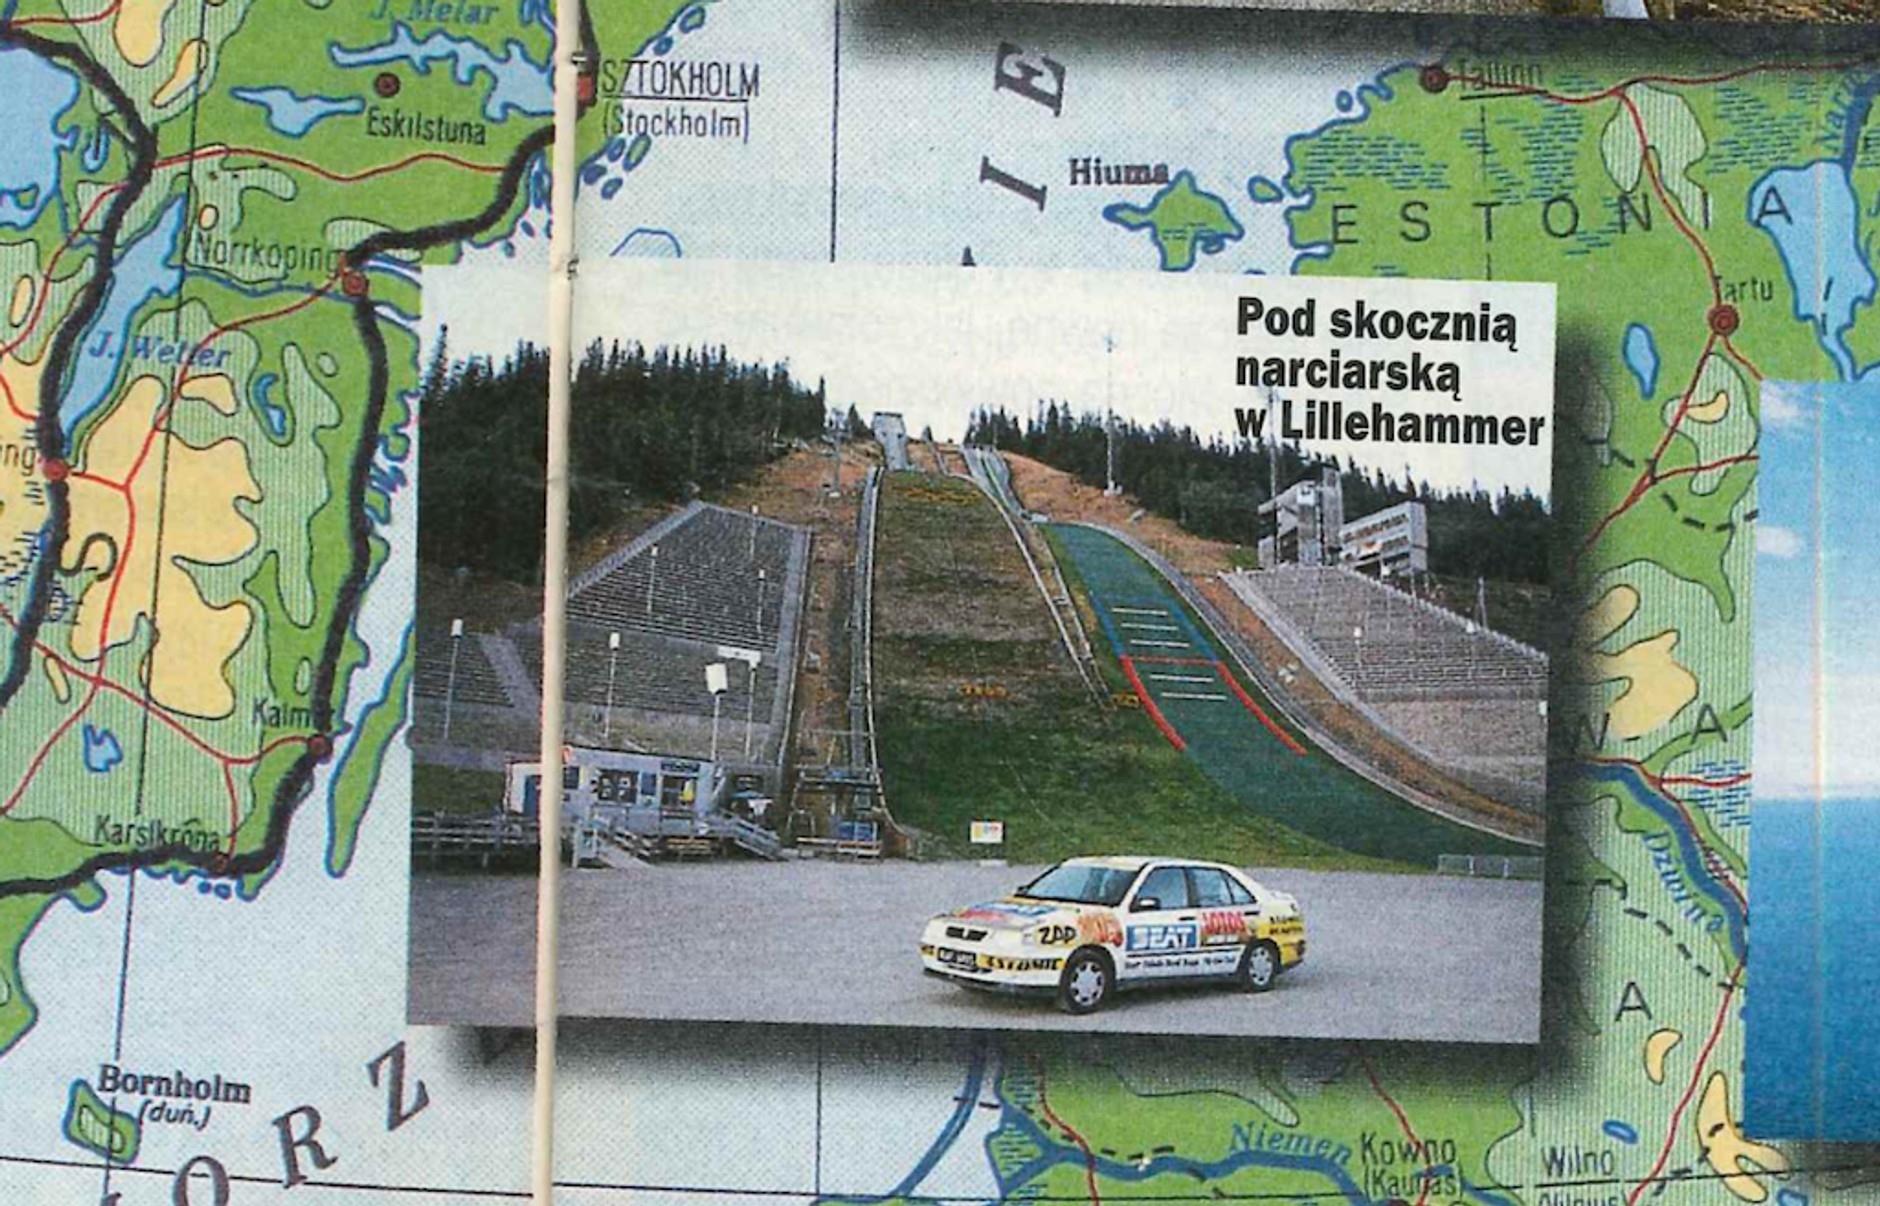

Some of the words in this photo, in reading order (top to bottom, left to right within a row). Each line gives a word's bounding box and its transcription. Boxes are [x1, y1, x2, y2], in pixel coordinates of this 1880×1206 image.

[602, 60, 760, 97] SZTOKHOLM
[366, 105, 486, 146] Eskilstuna
[603, 101, 749, 144] (Stockholm)
[1069, 157, 1169, 186] Hiuma
[1332, 185, 1793, 246] ESTONIA
[1237, 296, 1316, 337] Pod
[1330, 300, 1518, 352] skocznią
[1236, 349, 1462, 401] narciarską
[1234, 408, 1267, 438] w
[1281, 400, 1546, 446] Lillehammer
[98, 1064, 251, 1104] Bornholm
[1229, 1120, 1352, 1165] Niemen
[1361, 1131, 1456, 1167] Kowno
[1541, 1146, 1614, 1177] Wilno
